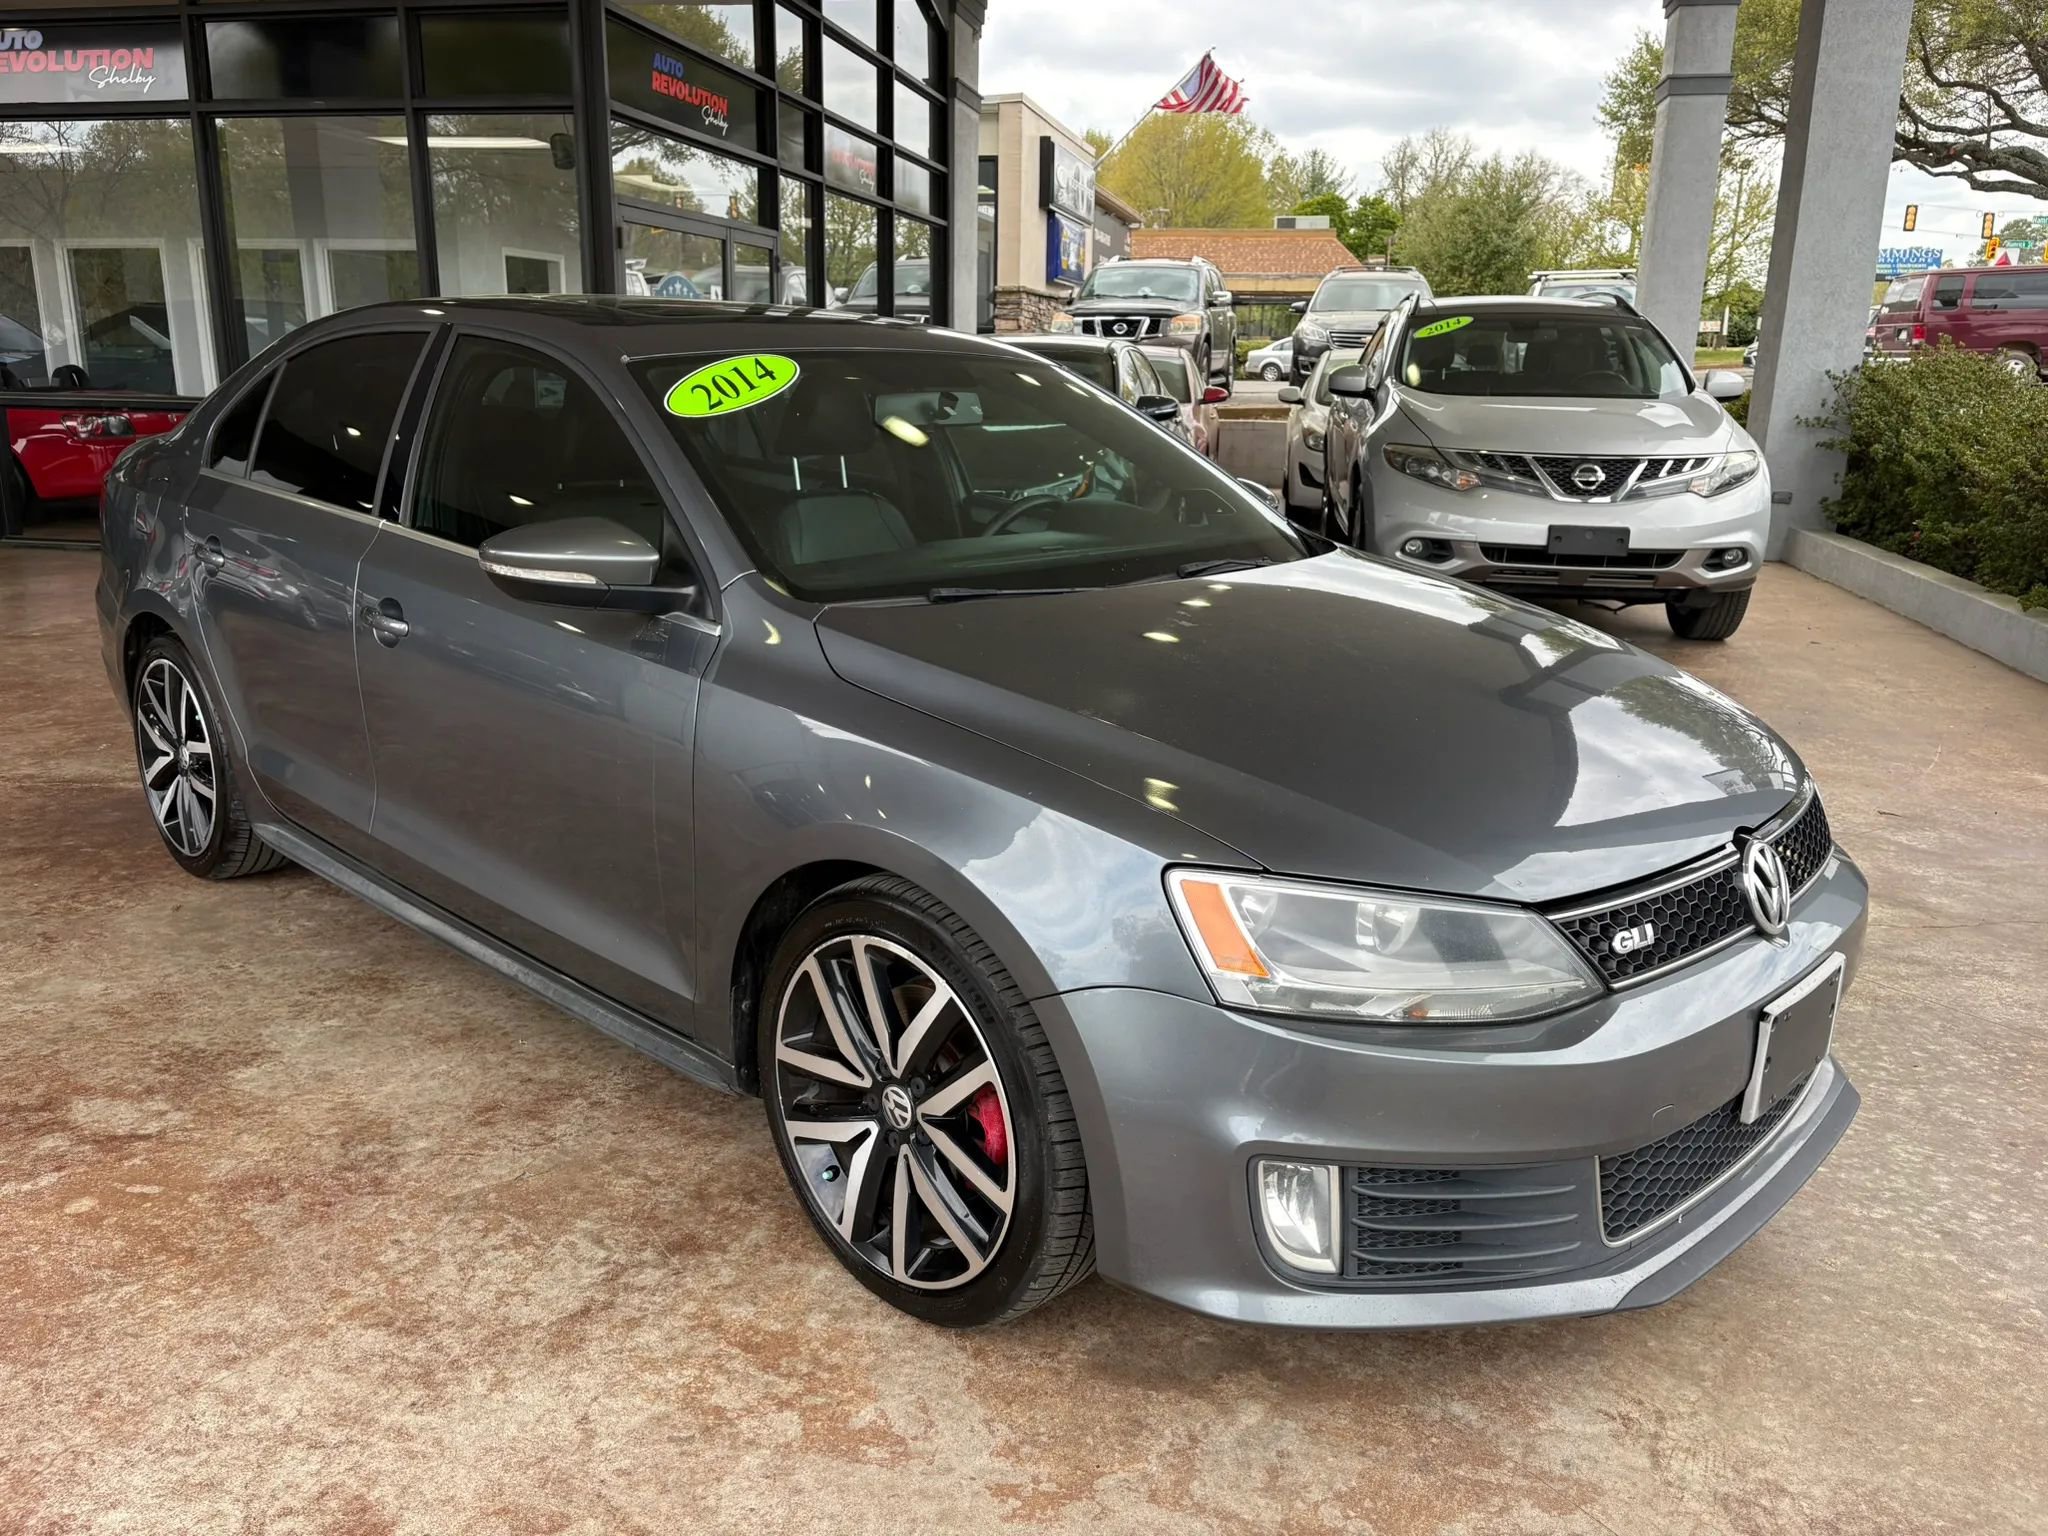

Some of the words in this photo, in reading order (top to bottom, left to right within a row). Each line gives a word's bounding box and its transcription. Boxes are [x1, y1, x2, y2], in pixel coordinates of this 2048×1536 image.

[0, 30, 43, 50] UTO
[0, 49, 154, 72] EVOLUTION
[653, 53, 684, 78] AUTO
[88, 63, 157, 93] Shelby
[652, 71, 729, 116] REVOLUTION
[1878, 248, 1941, 258] MMINGS
[1425, 317, 1462, 336] 2014
[690, 357, 777, 411] 2014
[1612, 922, 1655, 954] GLI
